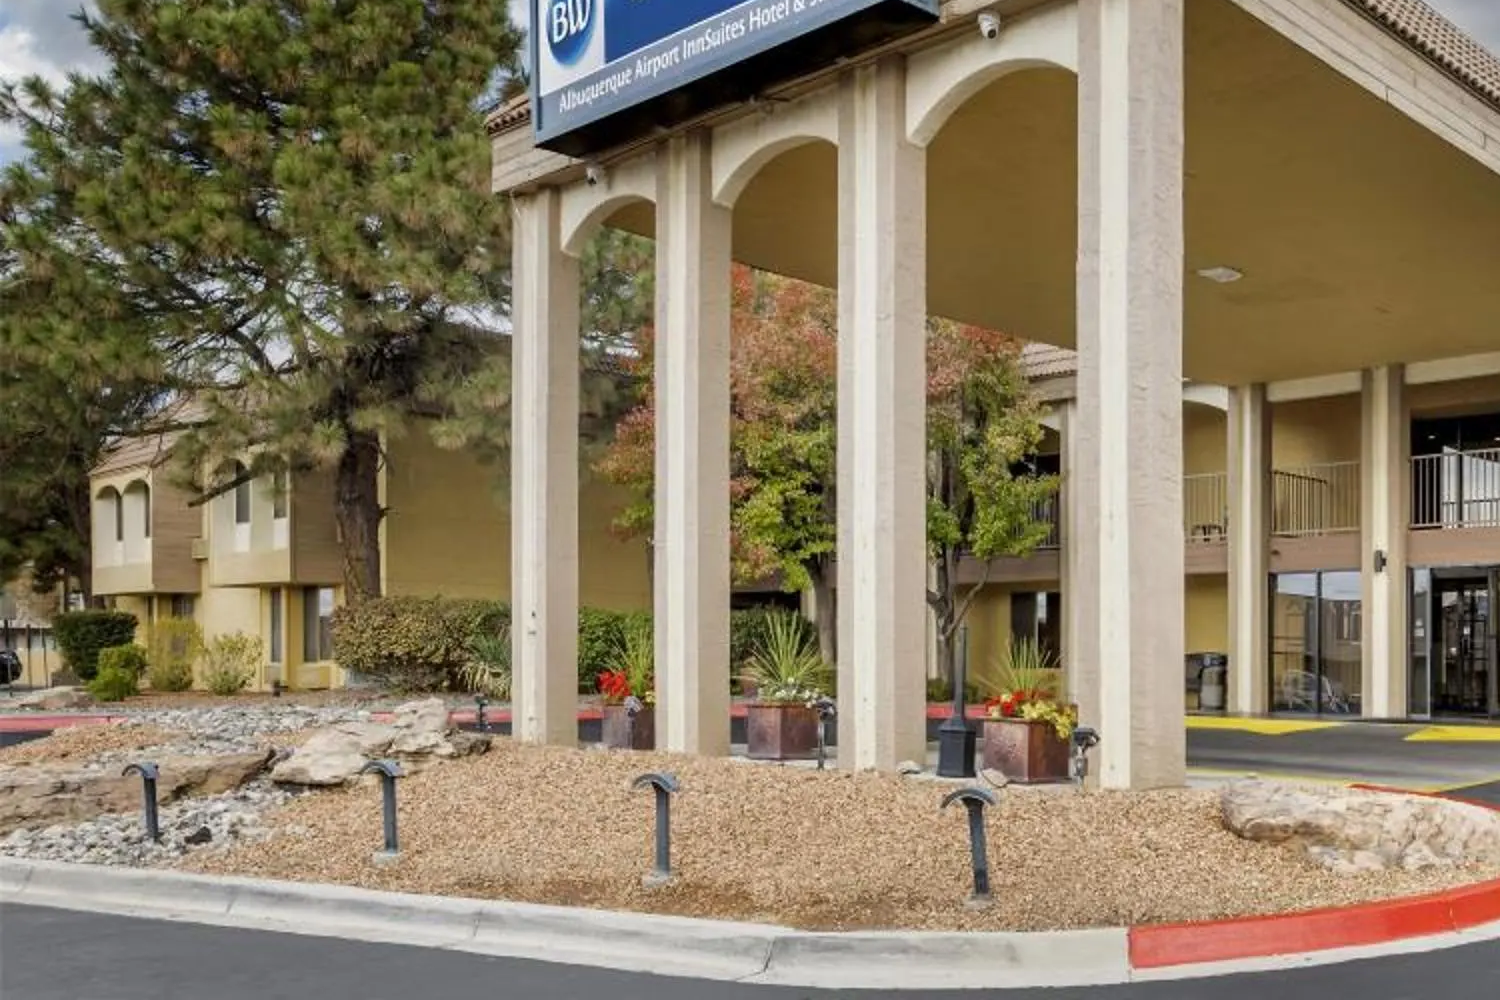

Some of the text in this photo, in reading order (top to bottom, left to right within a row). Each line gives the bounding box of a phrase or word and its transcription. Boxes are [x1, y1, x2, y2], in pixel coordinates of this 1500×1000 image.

[559, 68, 632, 113] Albuquerque
[635, 45, 681, 79] Airport
[683, 18, 745, 60] InnSuites
